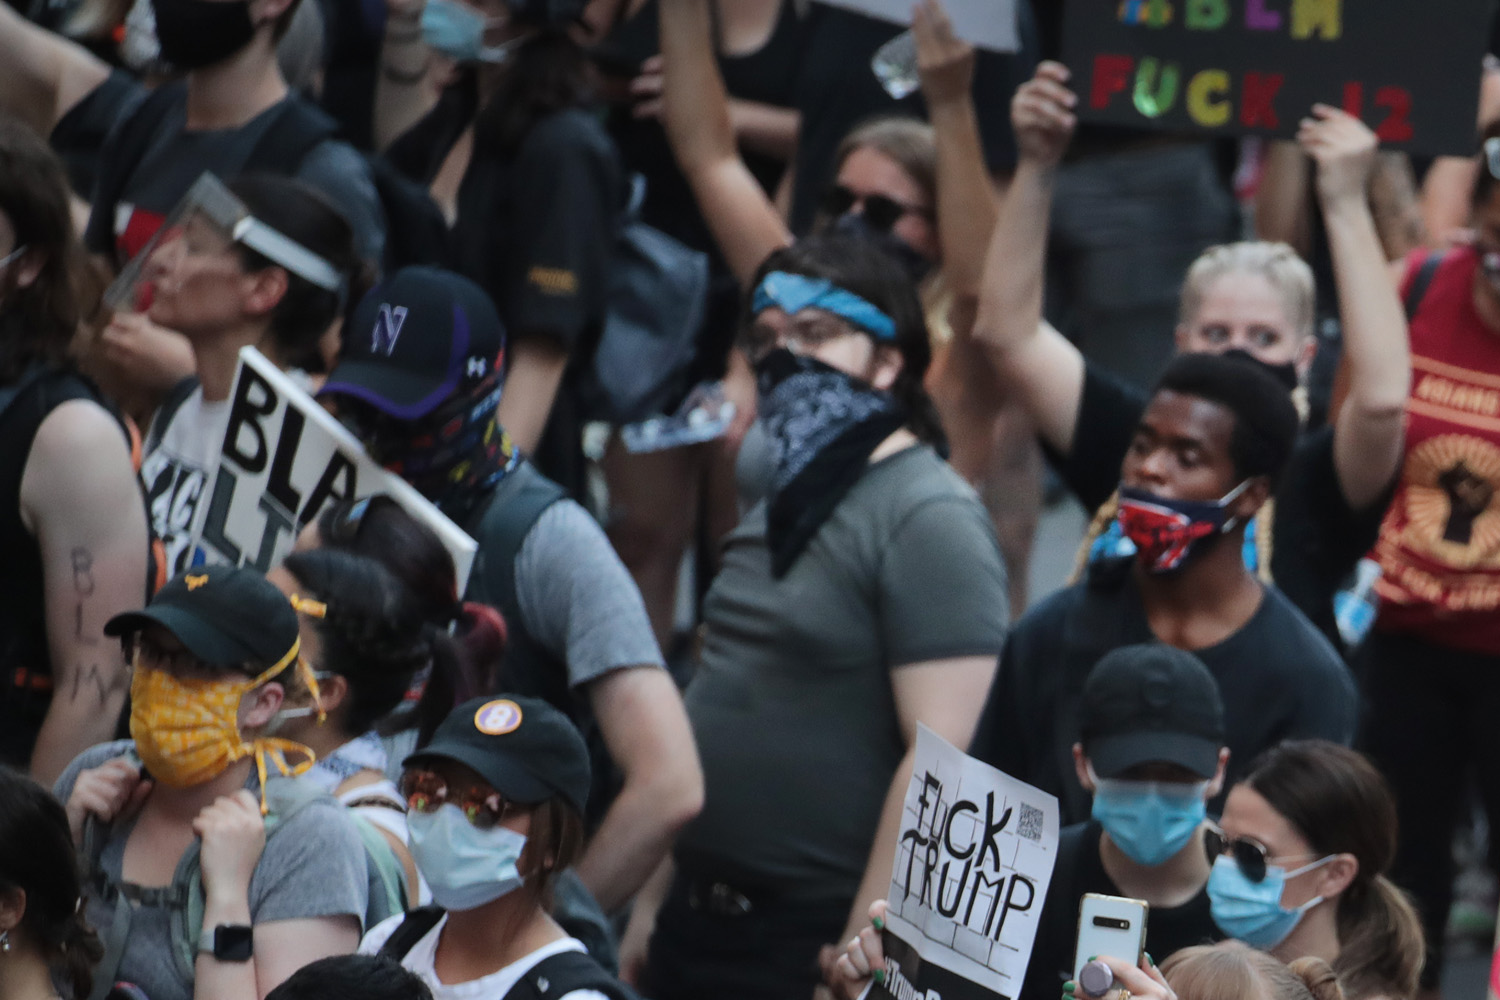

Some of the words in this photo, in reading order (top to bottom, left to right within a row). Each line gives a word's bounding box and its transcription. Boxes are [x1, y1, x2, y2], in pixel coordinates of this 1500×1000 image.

[1090, 55, 1285, 128] FUCK
[222, 360, 357, 526] BLA
[918, 769, 1013, 872] FUCK
[902, 829, 1036, 942] TRUMP
